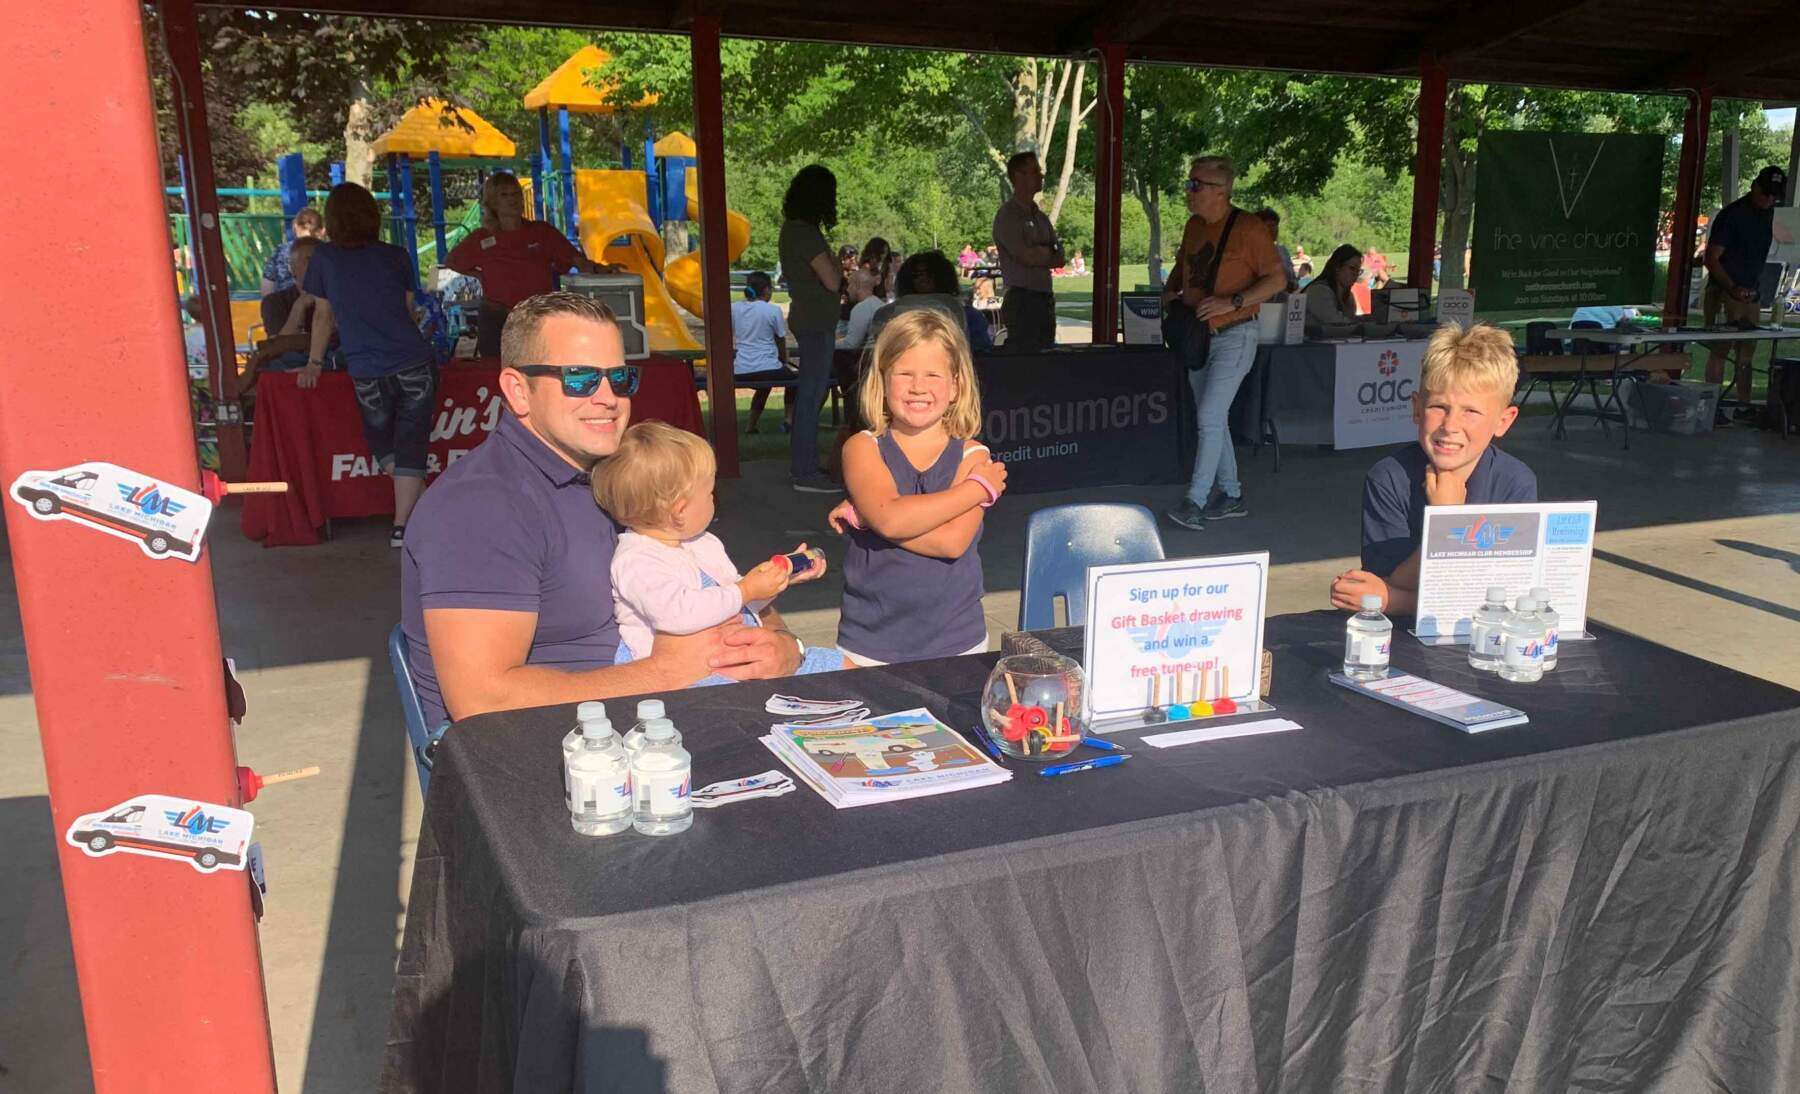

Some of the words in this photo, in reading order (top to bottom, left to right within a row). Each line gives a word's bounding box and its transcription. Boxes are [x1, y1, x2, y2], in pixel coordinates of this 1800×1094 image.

[1494, 226, 1522, 250] the
[1573, 225, 1639, 249] church
[1358, 378, 1413, 406] aac
[429, 386, 502, 442] in's
[986, 391, 1168, 445] onsumers
[1036, 441, 1079, 459] union
[1129, 588, 1157, 603] Sign
[1162, 588, 1179, 600] up
[1184, 583, 1203, 597] for
[1206, 583, 1229, 594] our
[1111, 615, 1137, 629] Gift
[1141, 611, 1185, 627] Basket
[1189, 606, 1243, 622] drawing
[1144, 636, 1169, 651] and
[1173, 634, 1197, 648] win
[1201, 635, 1209, 646] a
[1130, 664, 1158, 679] free
[1162, 657, 1219, 676] tune-up!
